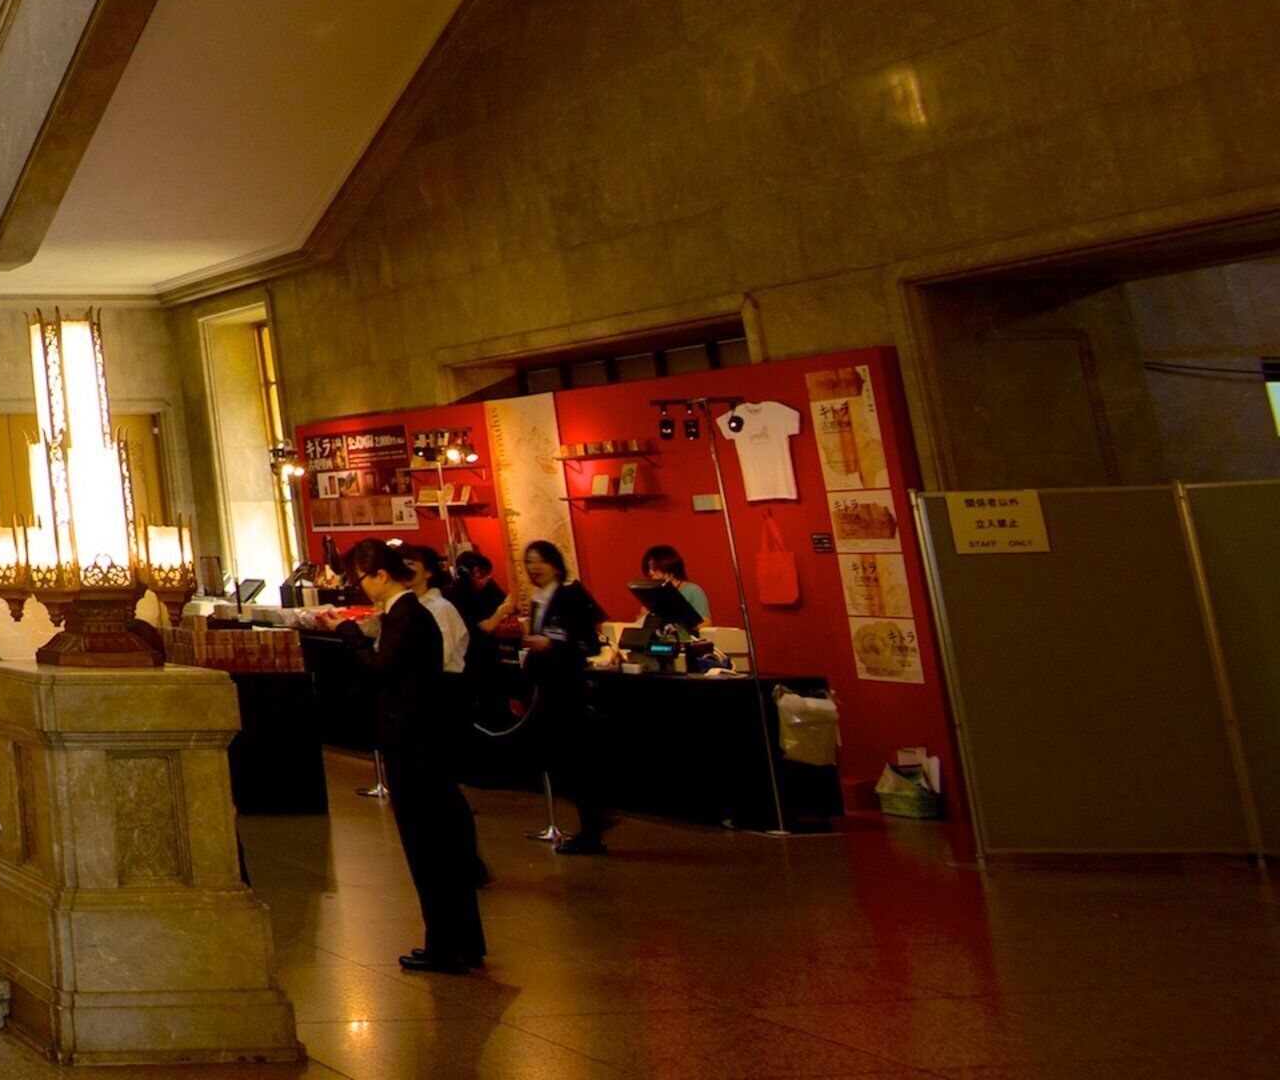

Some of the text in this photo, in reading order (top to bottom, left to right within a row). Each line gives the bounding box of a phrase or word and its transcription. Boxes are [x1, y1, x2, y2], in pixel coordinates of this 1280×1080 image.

[819, 399, 849, 420] キトラ
[305, 437, 331, 460] キトラ
[833, 498, 859, 512] キトラ
[964, 498, 1019, 508] 関係者以外
[975, 518, 1019, 529] 立入禁止
[968, 540, 997, 548] STAFF
[851, 561, 877, 574] キトラ
[888, 629, 915, 646] キトラ
